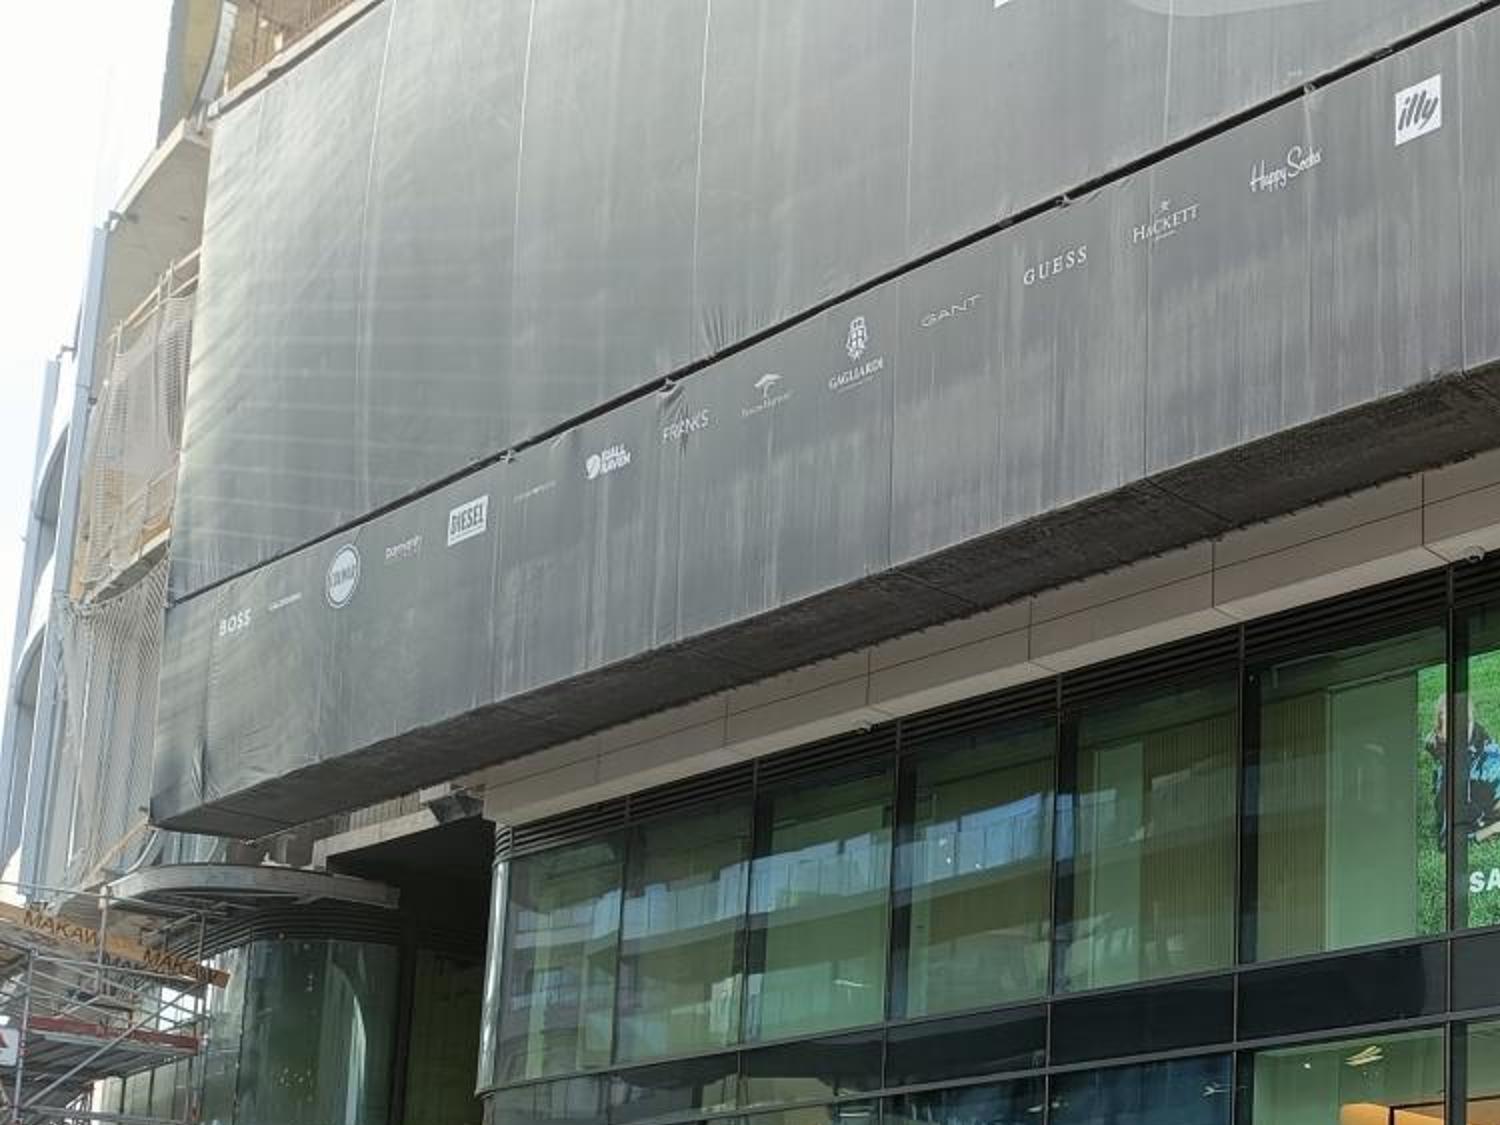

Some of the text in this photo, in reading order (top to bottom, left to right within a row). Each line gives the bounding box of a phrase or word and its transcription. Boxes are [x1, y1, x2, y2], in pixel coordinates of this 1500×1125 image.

[1397, 89, 1439, 131] illy
[1249, 145, 1322, 193] Happy Socks
[1022, 245, 1088, 285] GUESS
[450, 502, 484, 536] DIESEL
[218, 608, 252, 637] BOSS
